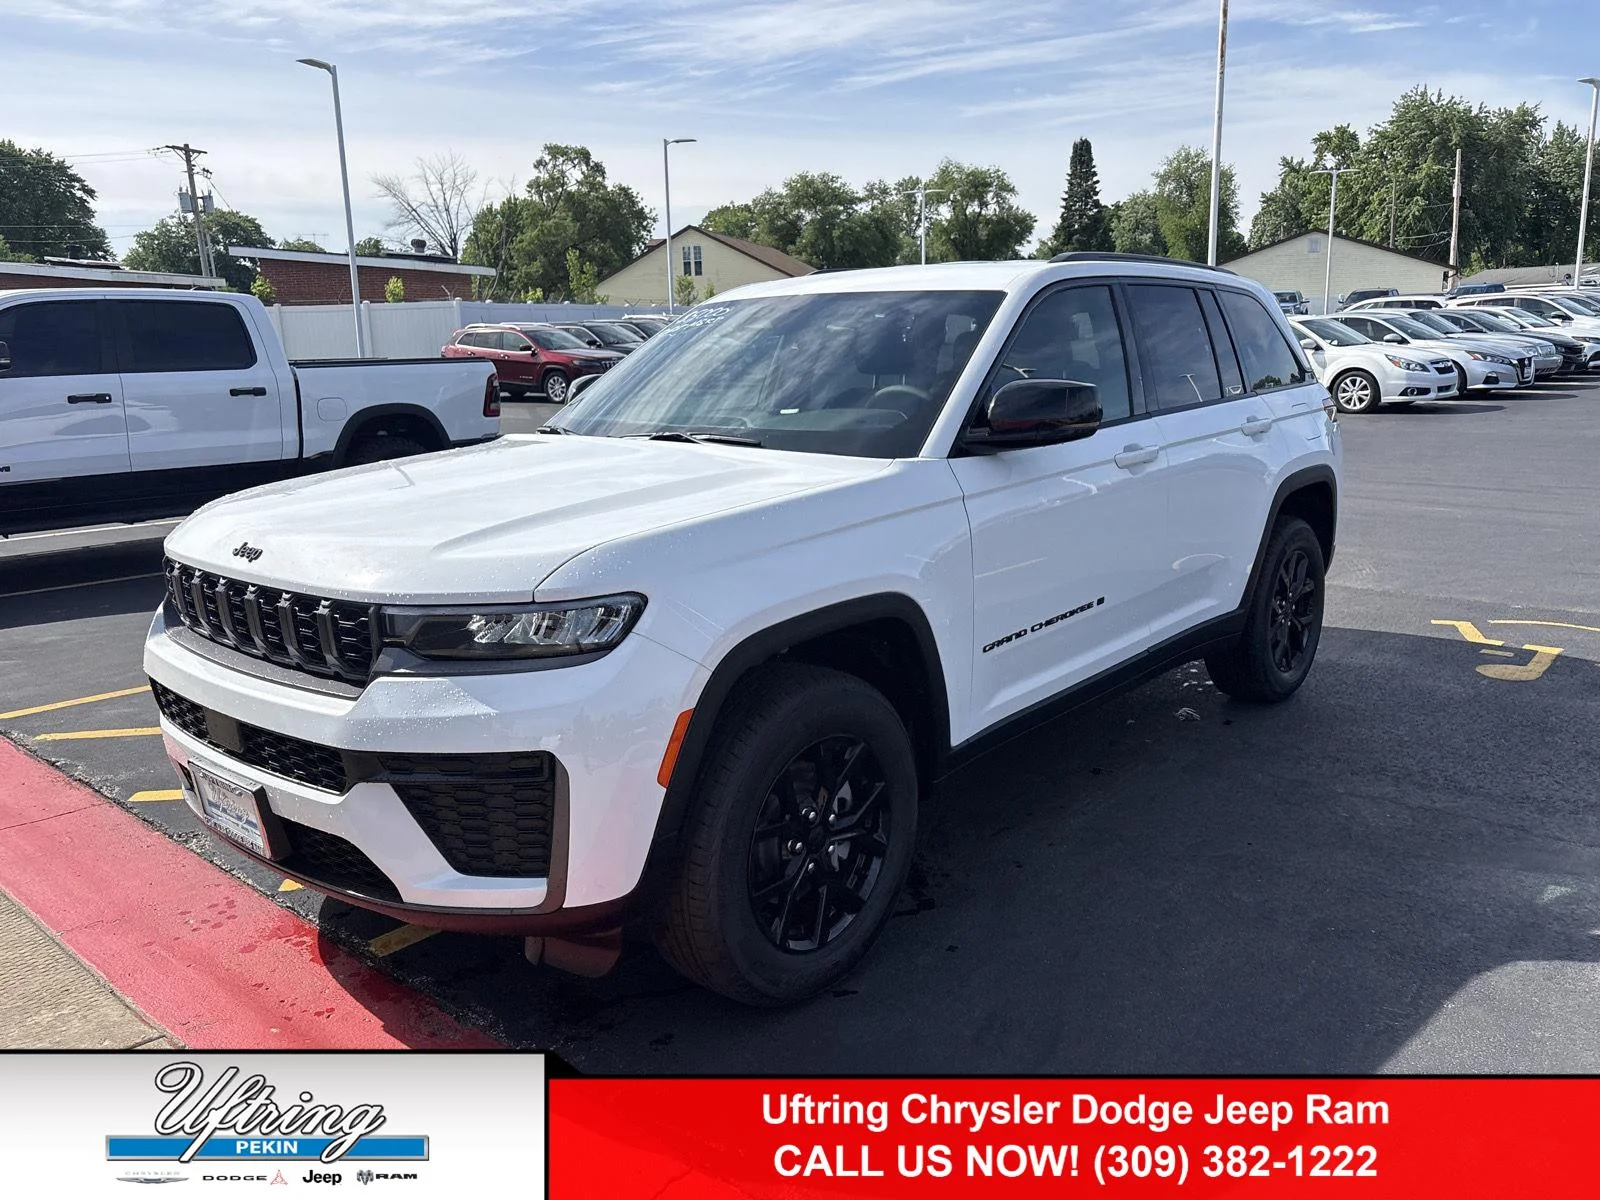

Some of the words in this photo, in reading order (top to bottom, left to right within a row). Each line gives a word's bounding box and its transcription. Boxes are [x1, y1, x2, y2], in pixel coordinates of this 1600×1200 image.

[232, 541, 264, 563] Jeep
[982, 628, 1028, 654] GRAND
[1030, 600, 1095, 633] CHEROKEE
